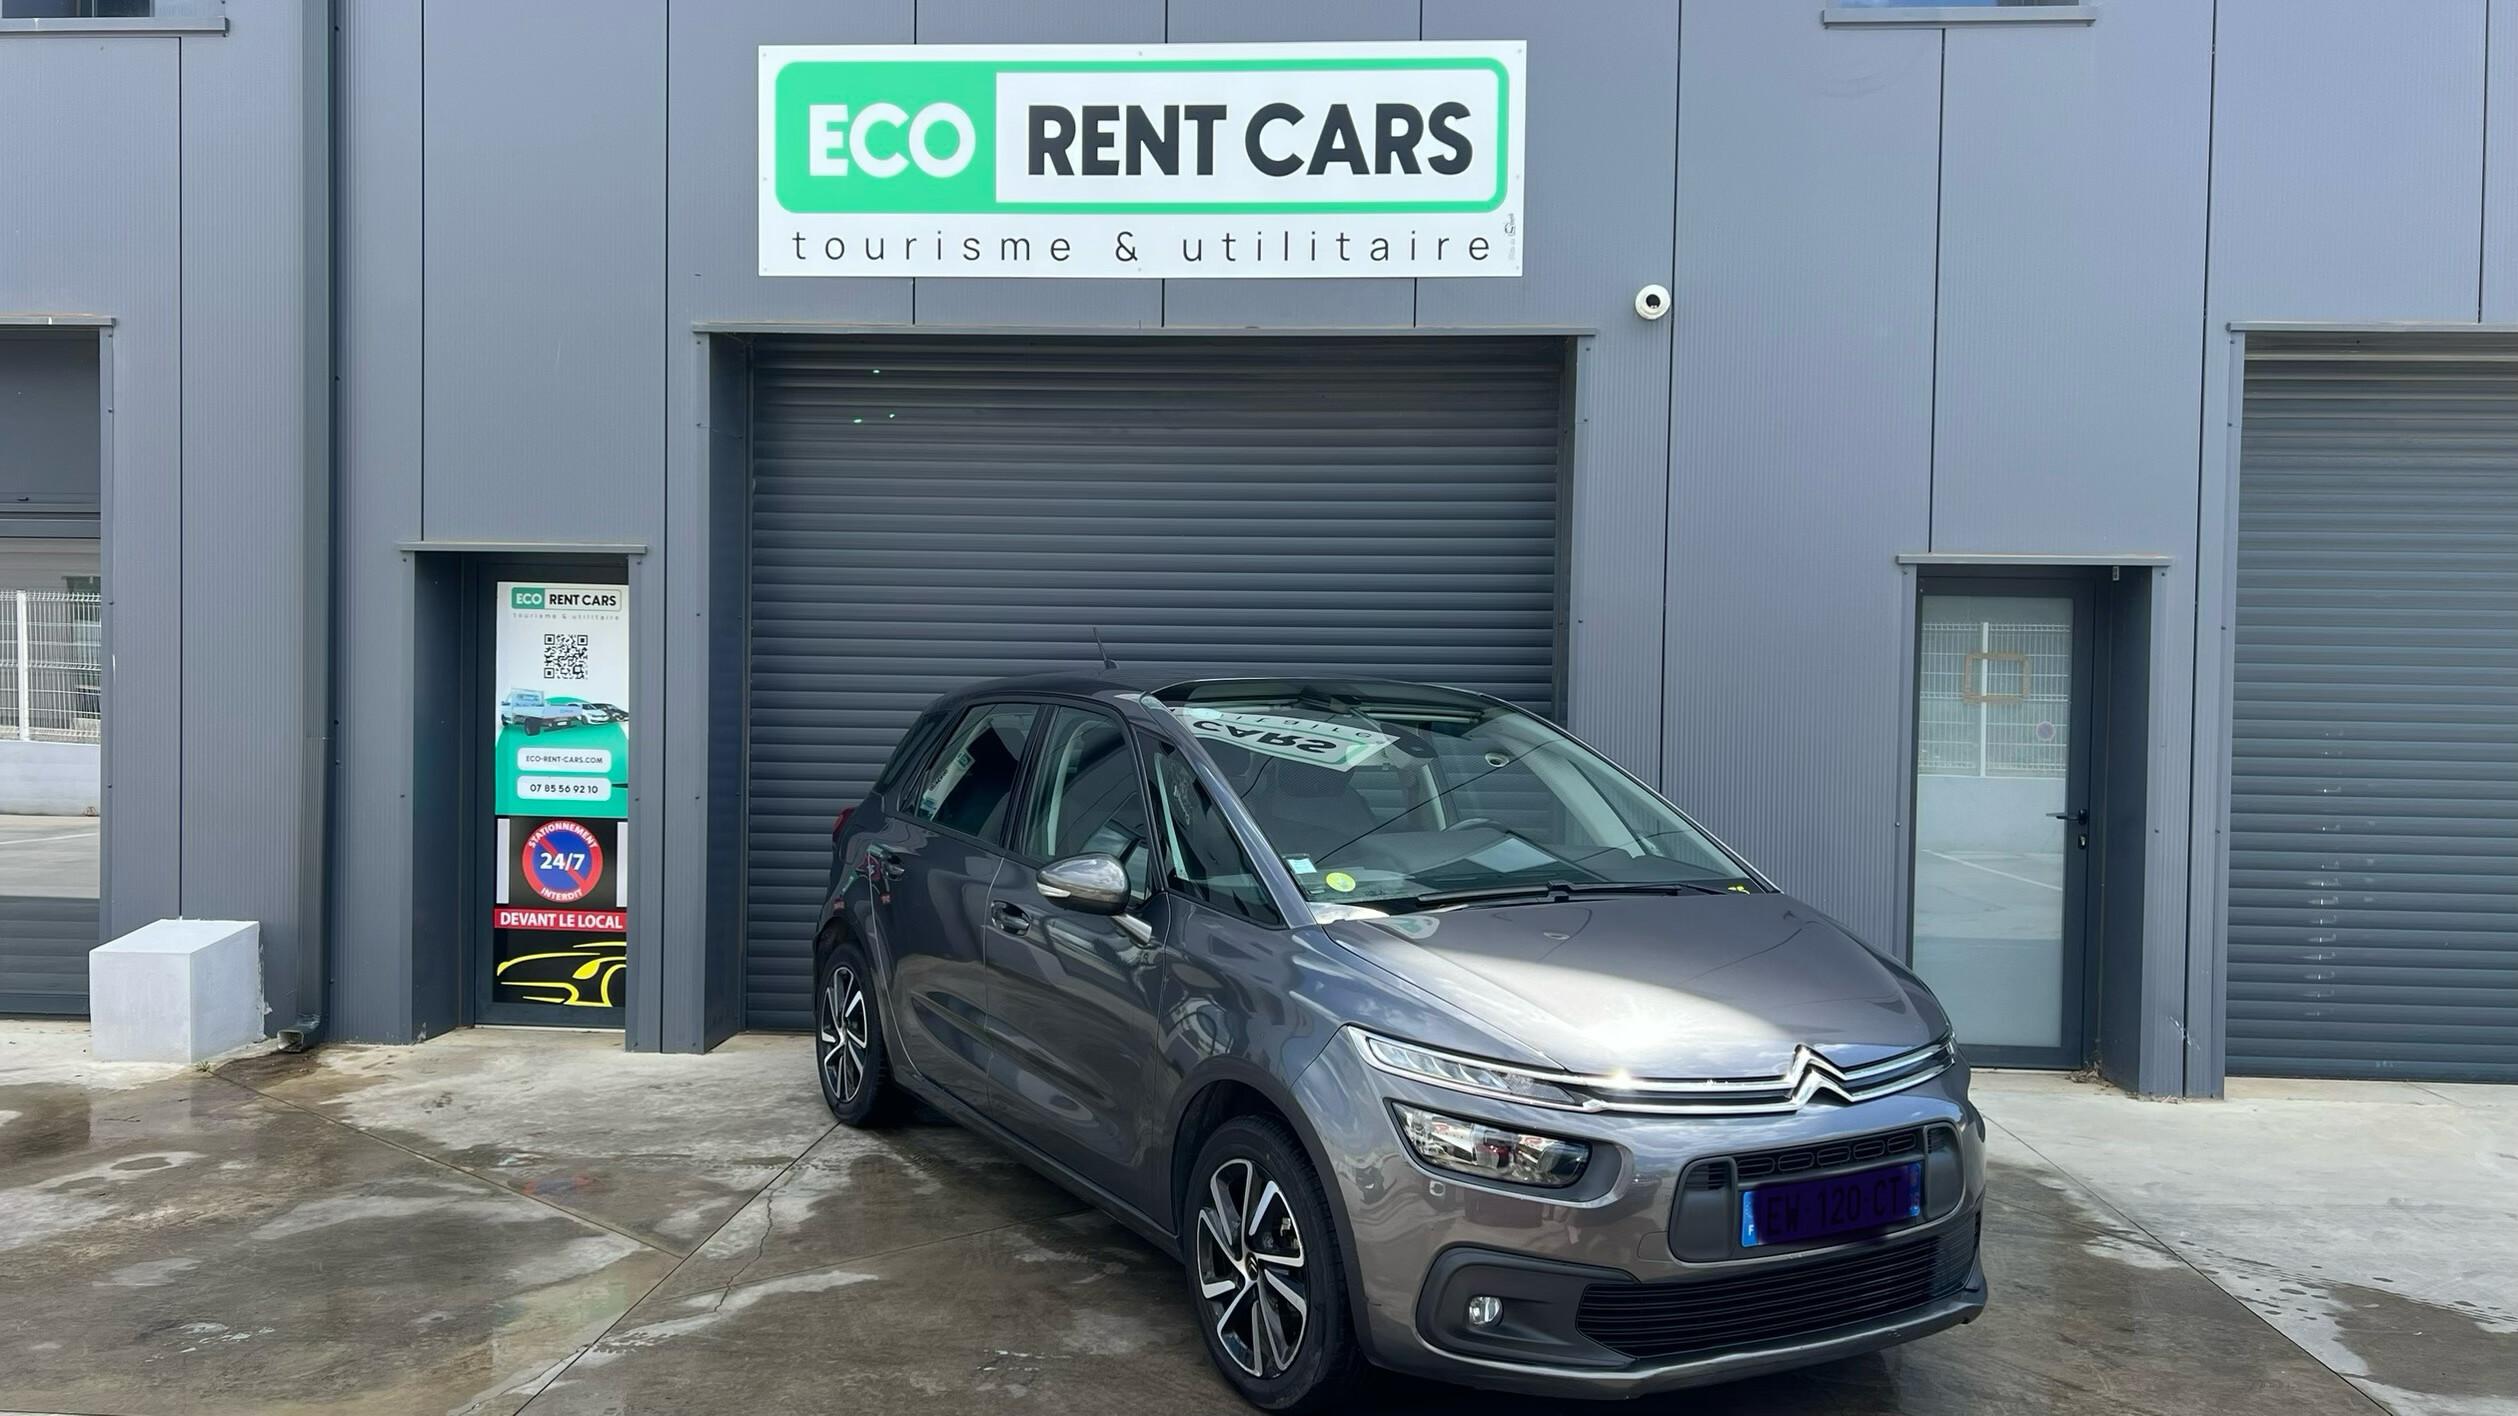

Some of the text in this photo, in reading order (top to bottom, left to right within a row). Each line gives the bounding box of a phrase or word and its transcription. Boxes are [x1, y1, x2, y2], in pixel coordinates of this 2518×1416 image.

[808, 100, 1474, 179] ECO RENT CARS
[791, 230, 1071, 263] tourisme
[1114, 230, 1139, 262] &
[1181, 229, 1491, 263] utilitaire
[515, 592, 617, 607] ECO RENT CARS
[525, 755, 603, 765] ECO-RENT-CARS.COM
[529, 783, 599, 794] 07 85 56 92 10
[527, 821, 599, 849] STATIONNEMENT
[539, 852, 585, 871] 24/7
[540, 886, 583, 901] INTERDIT
[500, 911, 624, 929] DEVANT LE LOCAL
